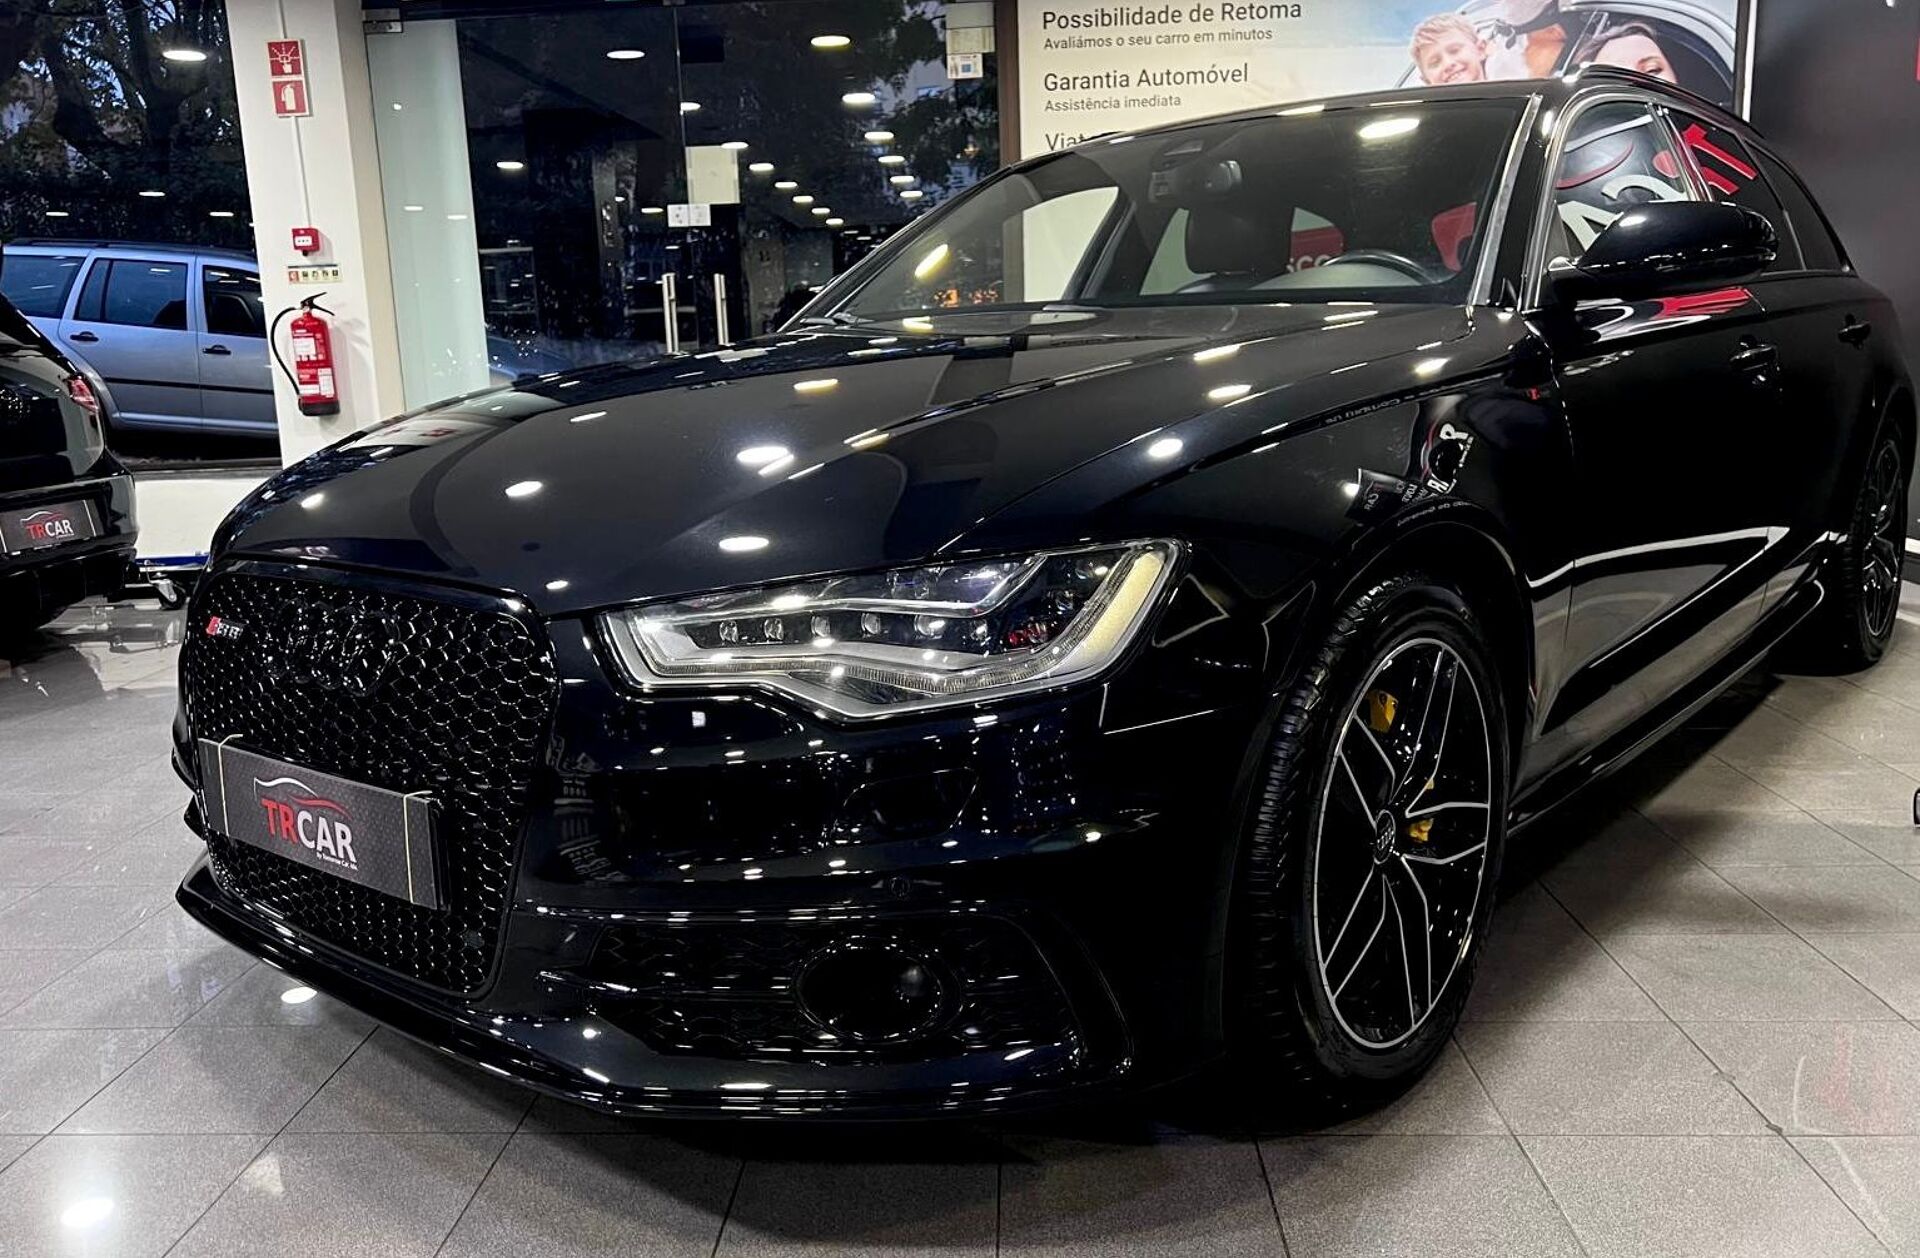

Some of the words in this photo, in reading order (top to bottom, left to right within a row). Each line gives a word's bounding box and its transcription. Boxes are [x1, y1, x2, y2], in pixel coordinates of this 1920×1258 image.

[1043, 5, 1182, 29] Possibilidade
[1189, 3, 1214, 22] de
[1221, 3, 1301, 20] Retoma
[1044, 36, 1112, 49] Avaliámos
[1116, 37, 1125, 46] o
[1128, 35, 1152, 46] seu
[1155, 33, 1190, 44] carro
[1193, 33, 1214, 43] em
[1218, 29, 1273, 41] minutos
[1044, 70, 1130, 91] Garantia
[1137, 63, 1248, 87] Automóvel
[1045, 98, 1120, 111] Assistência
[1124, 95, 1181, 108] imediata
[26, 519, 74, 539] TRCAR
[261, 800, 357, 863] TRCAR
